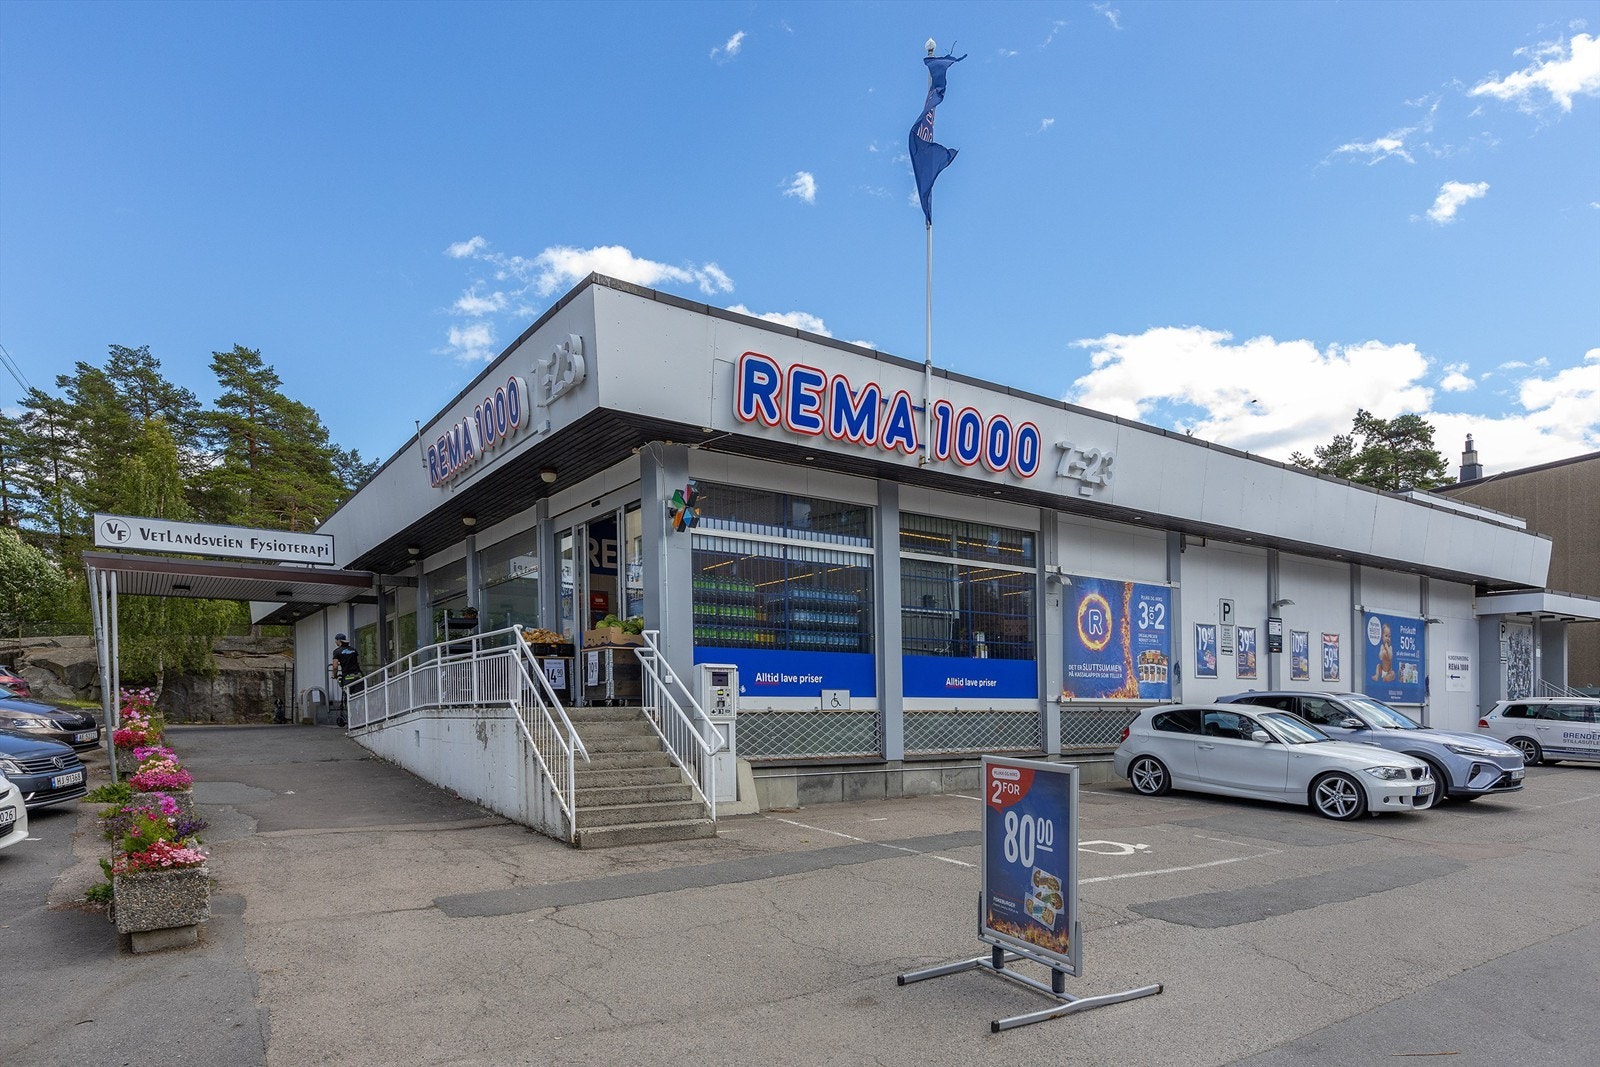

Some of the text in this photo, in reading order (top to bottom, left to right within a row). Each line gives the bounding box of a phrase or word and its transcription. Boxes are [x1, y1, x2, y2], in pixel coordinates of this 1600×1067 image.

[735, 351, 1042, 479] REMA 1000
[427, 376, 524, 488] REMA 1000
[1055, 440, 1118, 487] 7-23
[1088, 609, 1103, 635] R
[1138, 601, 1149, 630] 3
[1154, 603, 1165, 630] 2
[1223, 602, 1231, 621] P
[1400, 636, 1416, 651] 50%
[755, 672, 823, 686] Alltid lave priser
[946, 677, 997, 689] Alltid lave priser
[57, 777, 64, 786] HJ
[992, 780, 1020, 804] 2 FOR
